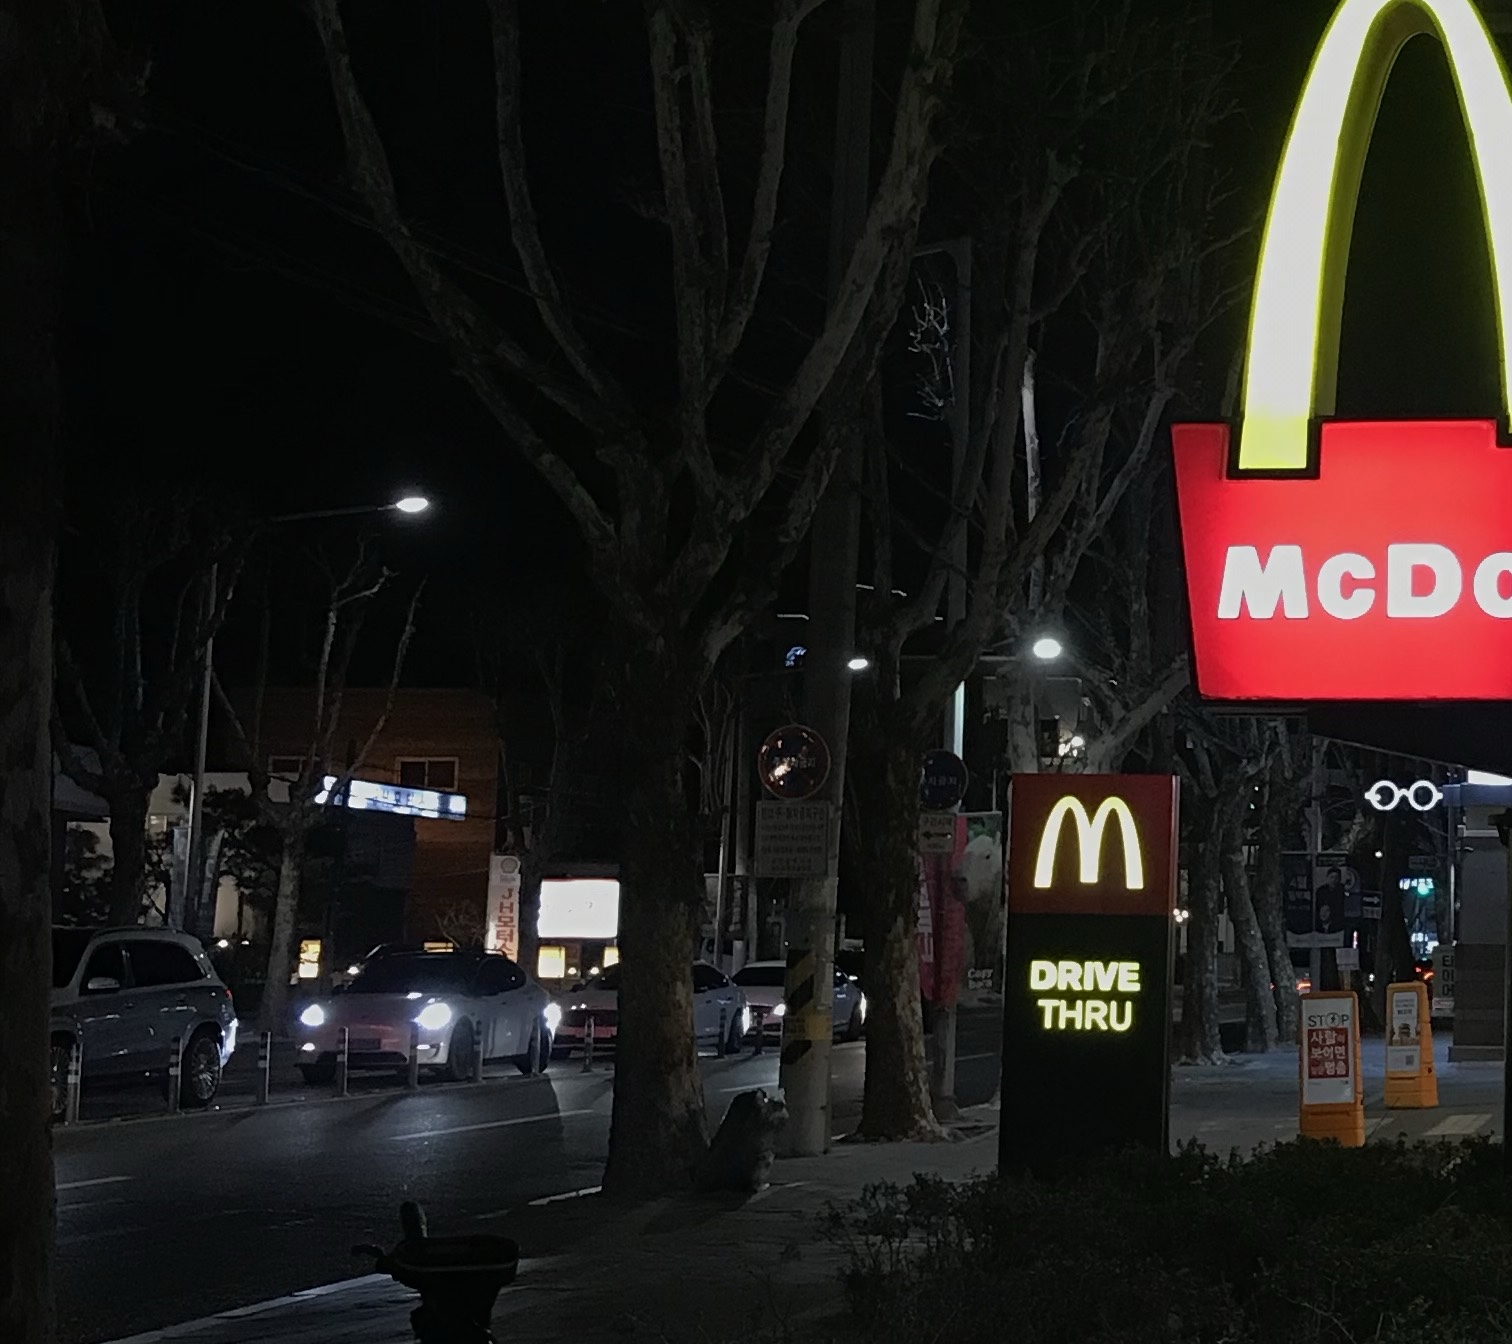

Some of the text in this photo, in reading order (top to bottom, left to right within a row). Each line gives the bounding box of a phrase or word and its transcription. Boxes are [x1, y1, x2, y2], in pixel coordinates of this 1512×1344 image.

[1030, 959, 1141, 993] DRIVE
[1037, 998, 1133, 1032] THRU
[1310, 1045, 1346, 1060] 보이면
